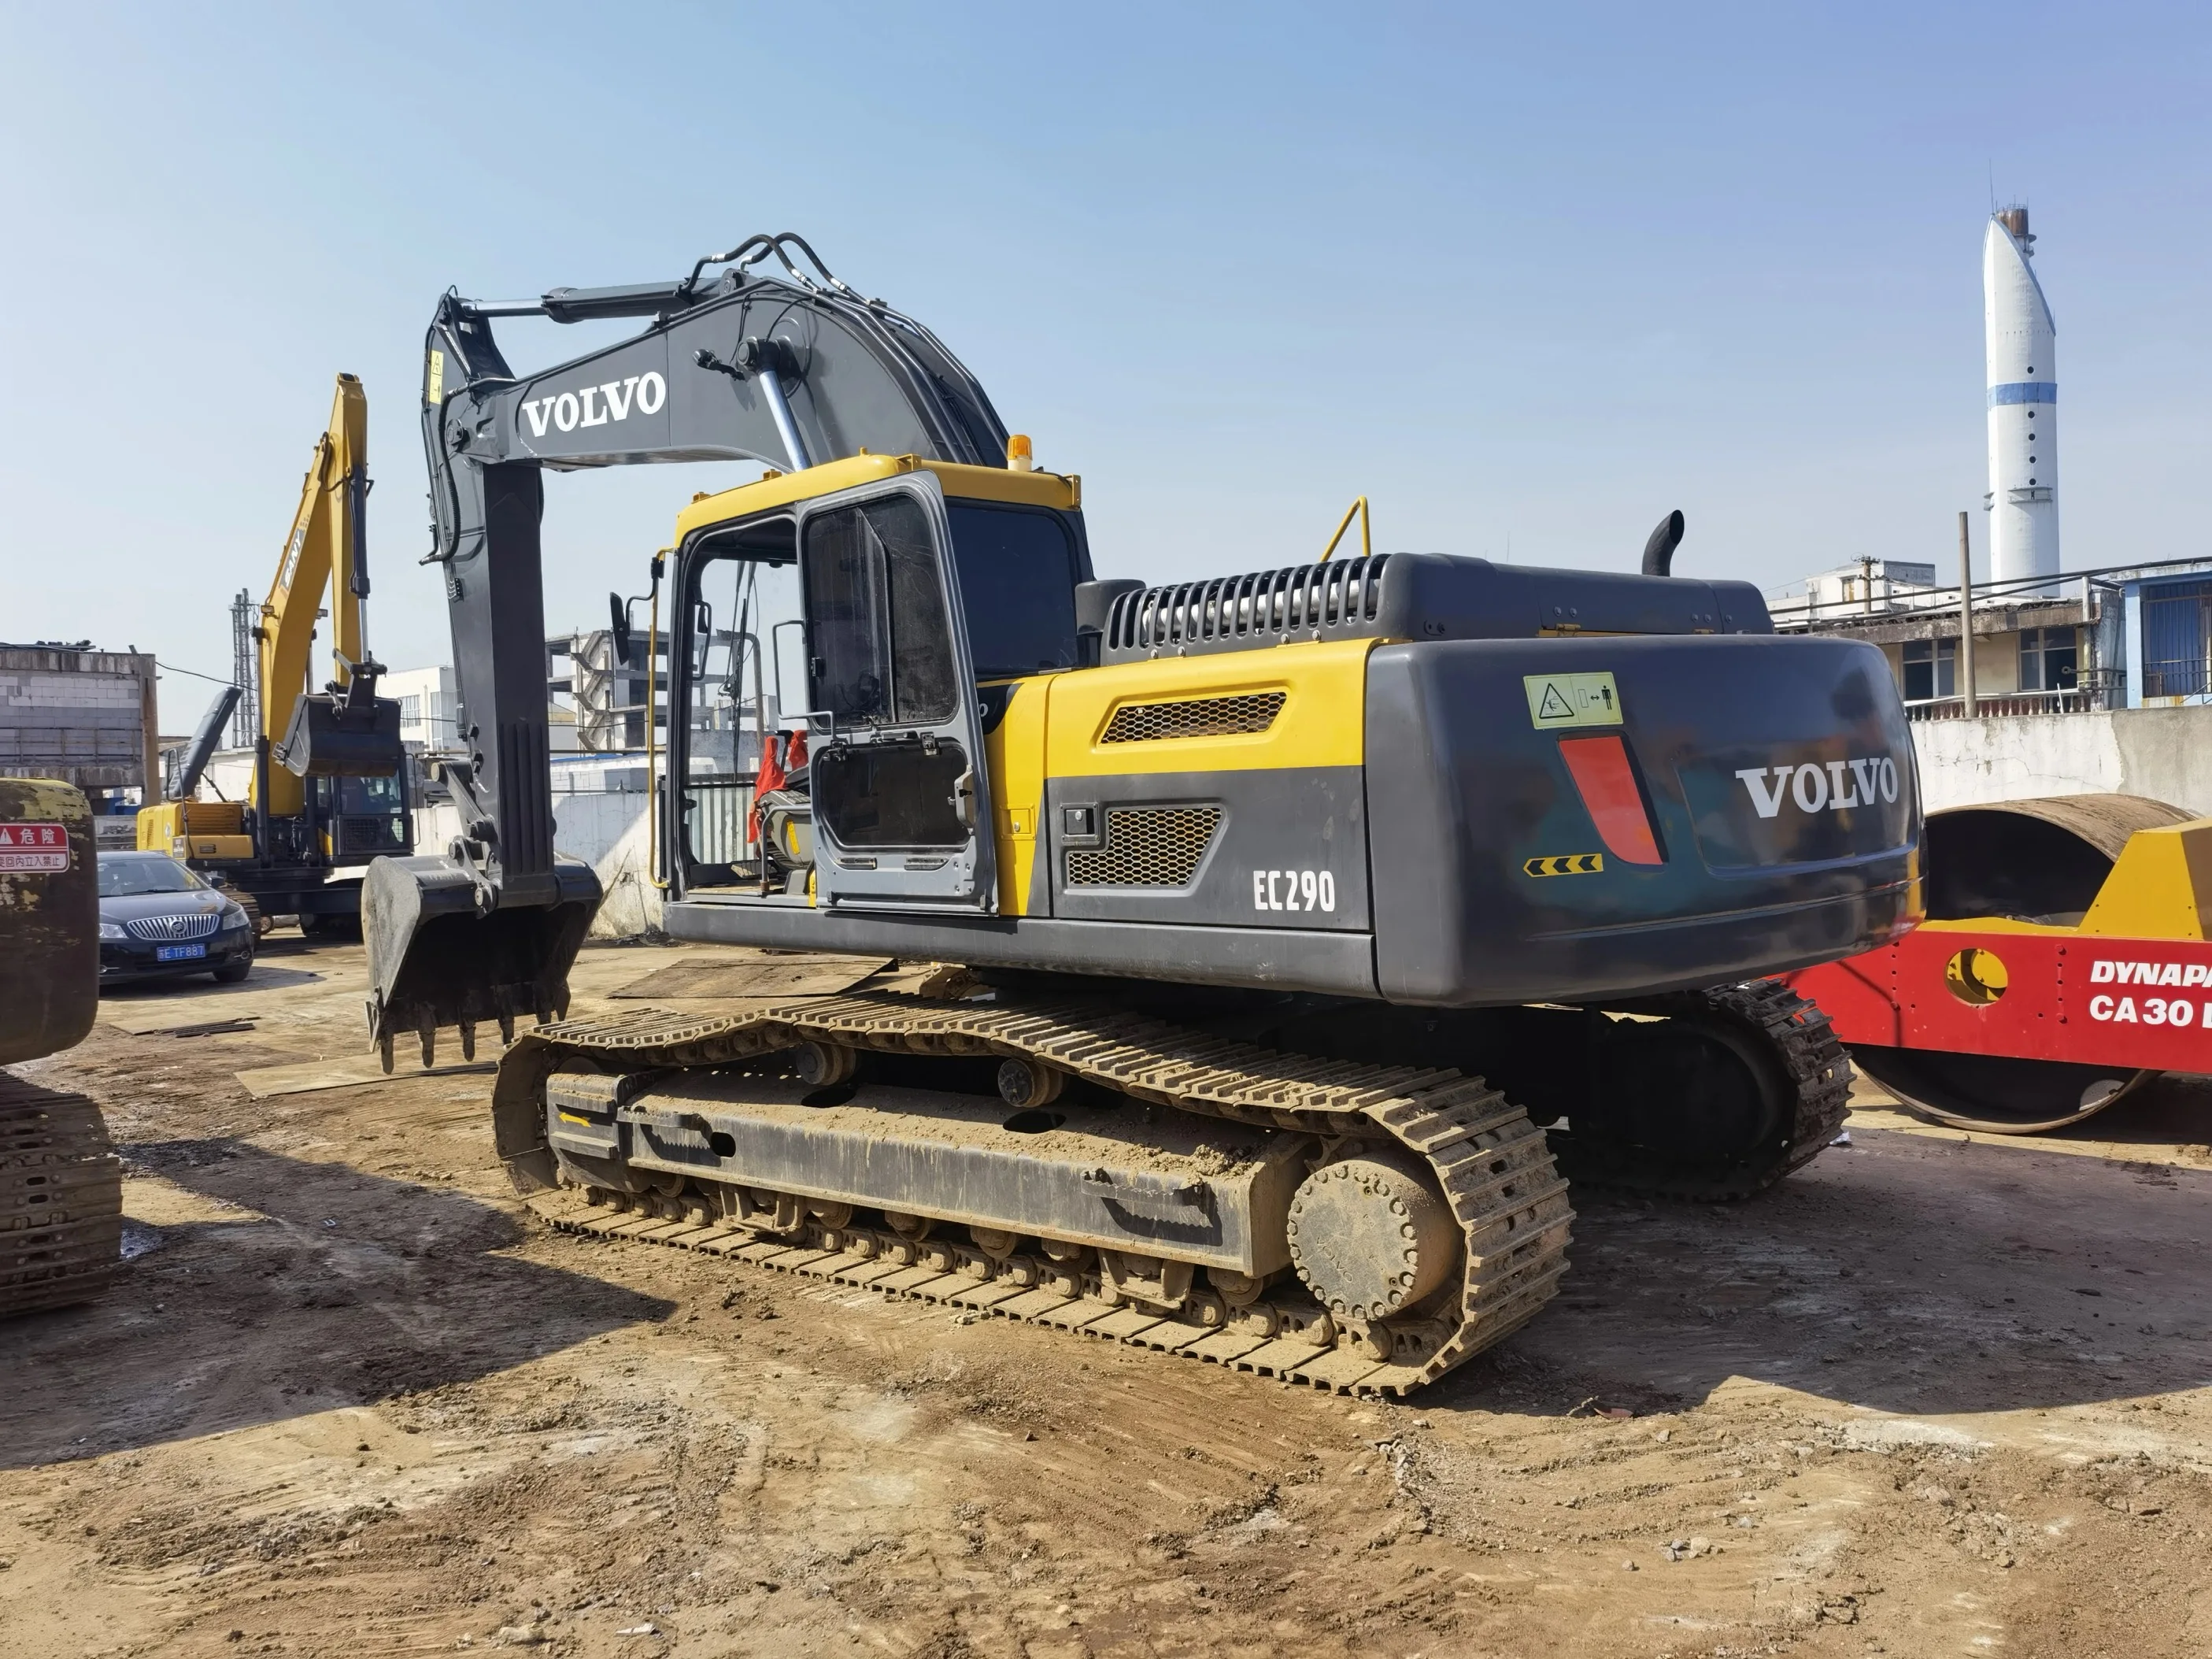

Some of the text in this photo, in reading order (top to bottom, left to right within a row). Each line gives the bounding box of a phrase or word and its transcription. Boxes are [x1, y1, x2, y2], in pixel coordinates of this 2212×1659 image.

[522, 371, 666, 437] VOLVO
[284, 530, 301, 587] SANY
[1735, 757, 1898, 818] VOLVO
[1253, 870, 1335, 912] EC290
[1316, 1235, 1353, 1283] VOLVO
